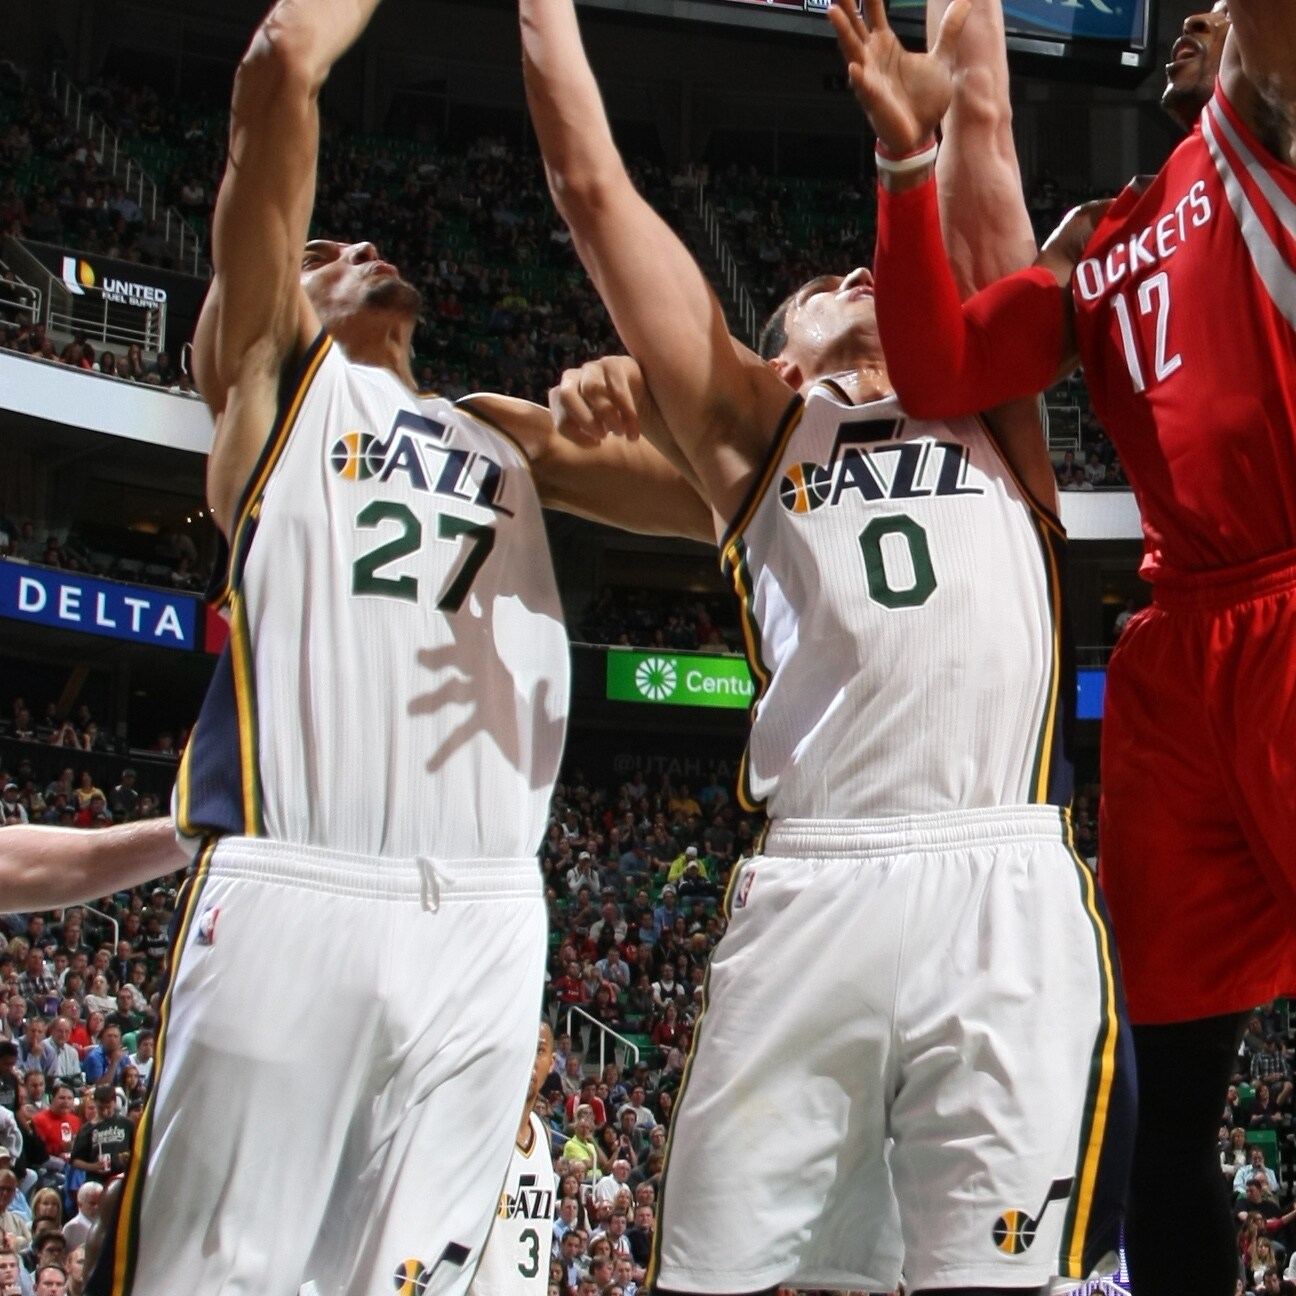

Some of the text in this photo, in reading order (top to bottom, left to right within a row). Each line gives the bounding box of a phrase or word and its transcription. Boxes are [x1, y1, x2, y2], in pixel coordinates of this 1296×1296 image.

[103, 277, 167, 302] UNITED
[1075, 179, 1212, 301] OCKETS
[1110, 270, 1182, 394] 12
[330, 408, 515, 520] JAZZ
[778, 417, 985, 516] JAZZ
[351, 500, 496, 615] 27
[858, 512, 938, 612] 0
[18, 576, 184, 640] DELTA
[686, 671, 754, 697] Centu
[518, 1228, 540, 1278] 3
